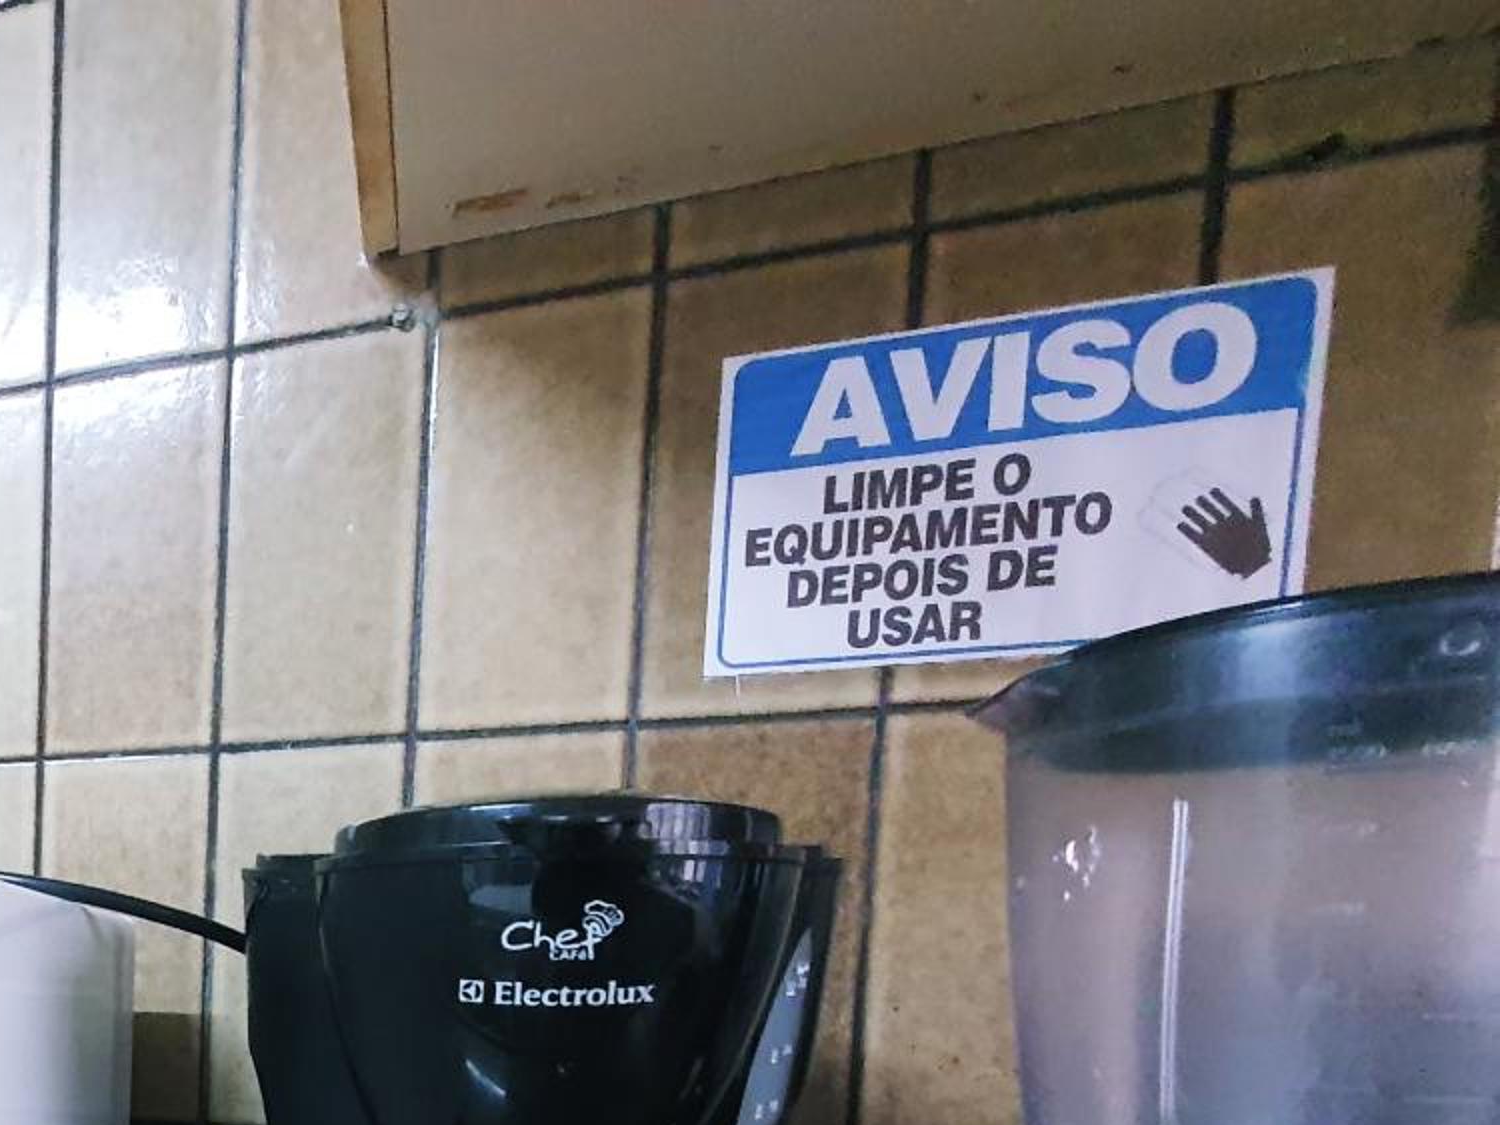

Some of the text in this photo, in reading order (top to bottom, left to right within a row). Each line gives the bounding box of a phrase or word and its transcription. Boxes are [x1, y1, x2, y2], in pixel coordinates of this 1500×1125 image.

[789, 300, 1259, 458] AVISO
[822, 452, 1033, 515] LIMPE O
[744, 491, 1114, 567] EQUIPAMENTO
[785, 545, 1059, 609] DEPOIS DE
[845, 601, 983, 649] USAR
[494, 979, 656, 1007] Electrolux
